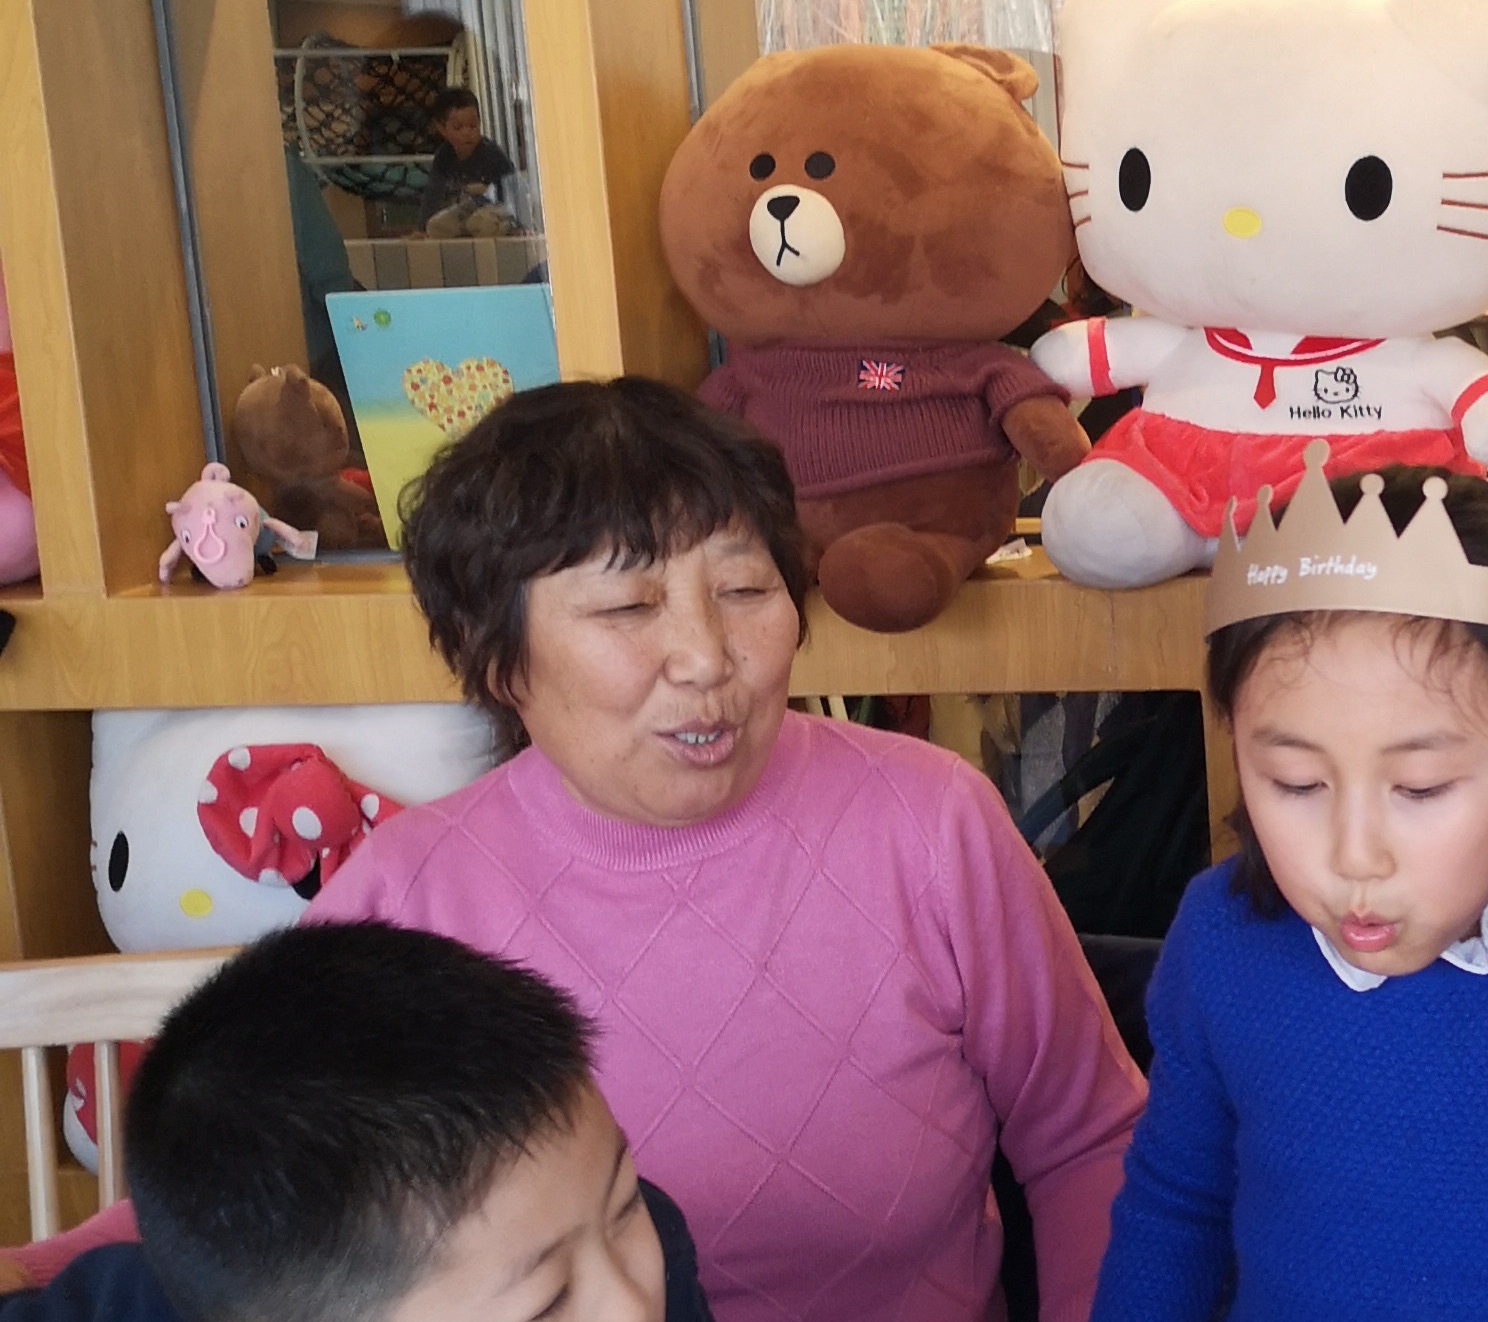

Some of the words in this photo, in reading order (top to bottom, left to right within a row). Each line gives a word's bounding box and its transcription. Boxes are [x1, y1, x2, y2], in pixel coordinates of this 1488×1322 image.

[1289, 405, 1332, 420] Hello
[1340, 405, 1383, 420] Kitty
[1246, 562, 1289, 587] Happy
[1298, 554, 1378, 581] Birthday
